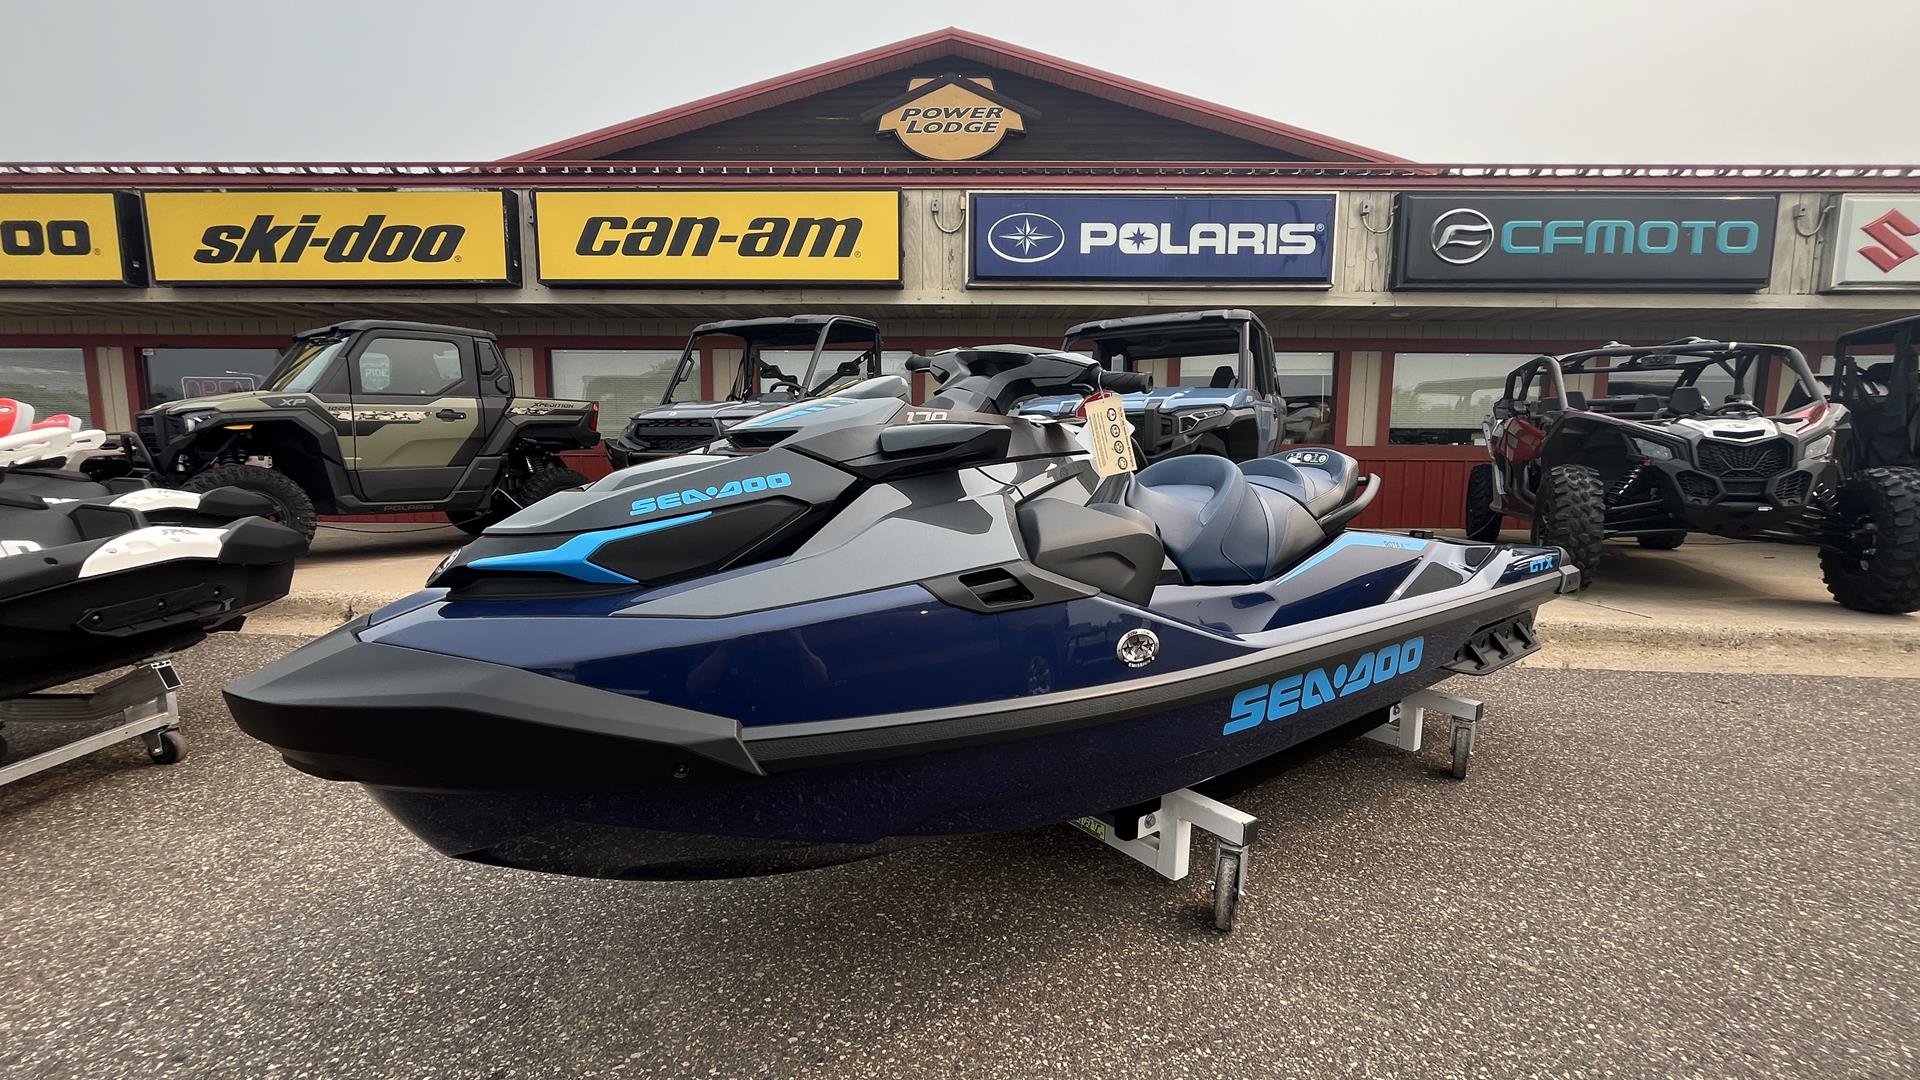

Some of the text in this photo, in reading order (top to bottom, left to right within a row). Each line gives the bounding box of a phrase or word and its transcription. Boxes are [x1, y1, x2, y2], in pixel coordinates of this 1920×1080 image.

[899, 107, 1004, 122] POWER
[905, 120, 1000, 134] LODGE
[193, 214, 466, 265] ski-doo
[575, 216, 864, 258] can-am
[1079, 222, 1317, 255] POLARIS
[1500, 219, 1760, 255] CFMOTO
[279, 398, 307, 407] XP
[531, 401, 575, 409] XPEDITION
[905, 410, 948, 423] 170
[383, 503, 435, 512] POLARIS
[1528, 555, 1554, 574] GTX
